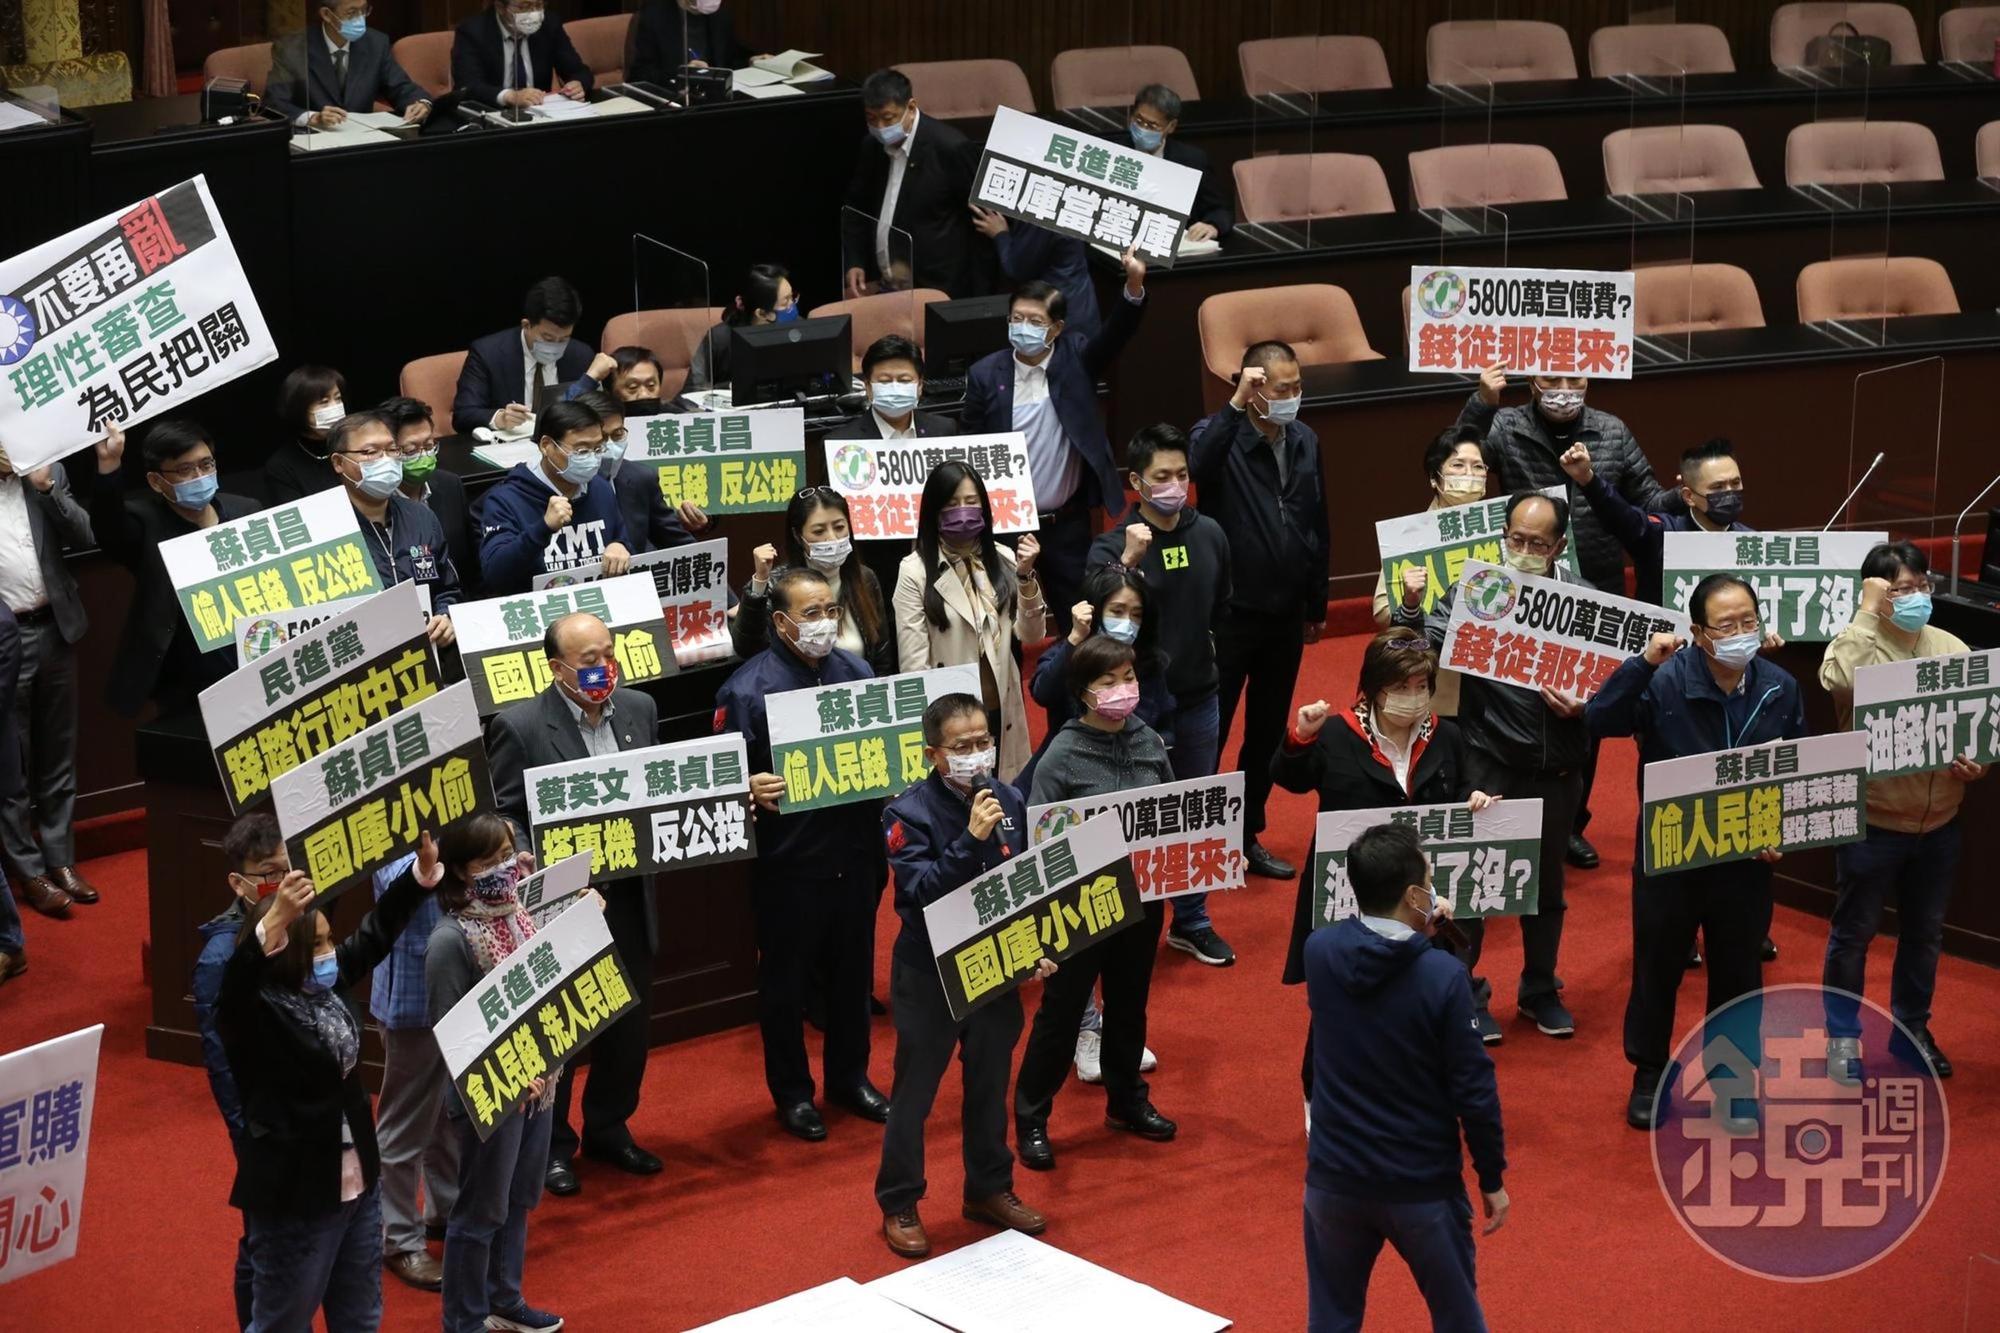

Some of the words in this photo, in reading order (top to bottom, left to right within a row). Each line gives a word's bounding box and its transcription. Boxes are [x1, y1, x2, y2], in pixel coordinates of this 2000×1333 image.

[1044, 133, 1144, 191] 民進黨
[978, 158, 1181, 257] 國庫當黨庫
[23, 196, 187, 335] 不要再亂
[1468, 279, 1631, 319] 5800萬宣傳費?
[8, 280, 187, 412] 理性審查
[77, 301, 250, 433] 為民把關
[1418, 323, 1631, 373] 錢從那裡來?
[646, 416, 752, 456] 蘇貞昌
[720, 459, 797, 506] 反公投
[205, 507, 313, 571] 蘇貞昌
[1437, 501, 1507, 542] 蘇貞昌
[1735, 536, 1820, 566] 蘇貞昌
[290, 543, 373, 607] 反公投
[259, 620, 366, 706] 民進黨
[1916, 654, 1989, 693] 蘇貞昌
[224, 649, 437, 804] 踐踏行政中立
[816, 677, 928, 733] 蘇貞昌
[322, 712, 431, 808] 蘇貞昌
[536, 768, 630, 815] 蔡英文
[644, 750, 742, 798] 蘇貞昌
[783, 736, 890, 803] 偷人民錢
[1715, 744, 1798, 785] 蘇貞昌
[303, 757, 476, 895] 國庫小偷
[650, 801, 749, 864] 反公投
[1651, 785, 1781, 869] 偷人民錢
[970, 837, 1078, 926] 蘇貞昌
[955, 875, 1125, 1003] 國庫小偷
[477, 941, 562, 1033] 民進黨
[466, 1022, 547, 1126] 拿人民錢
[538, 954, 632, 1057] 洗人民腦
